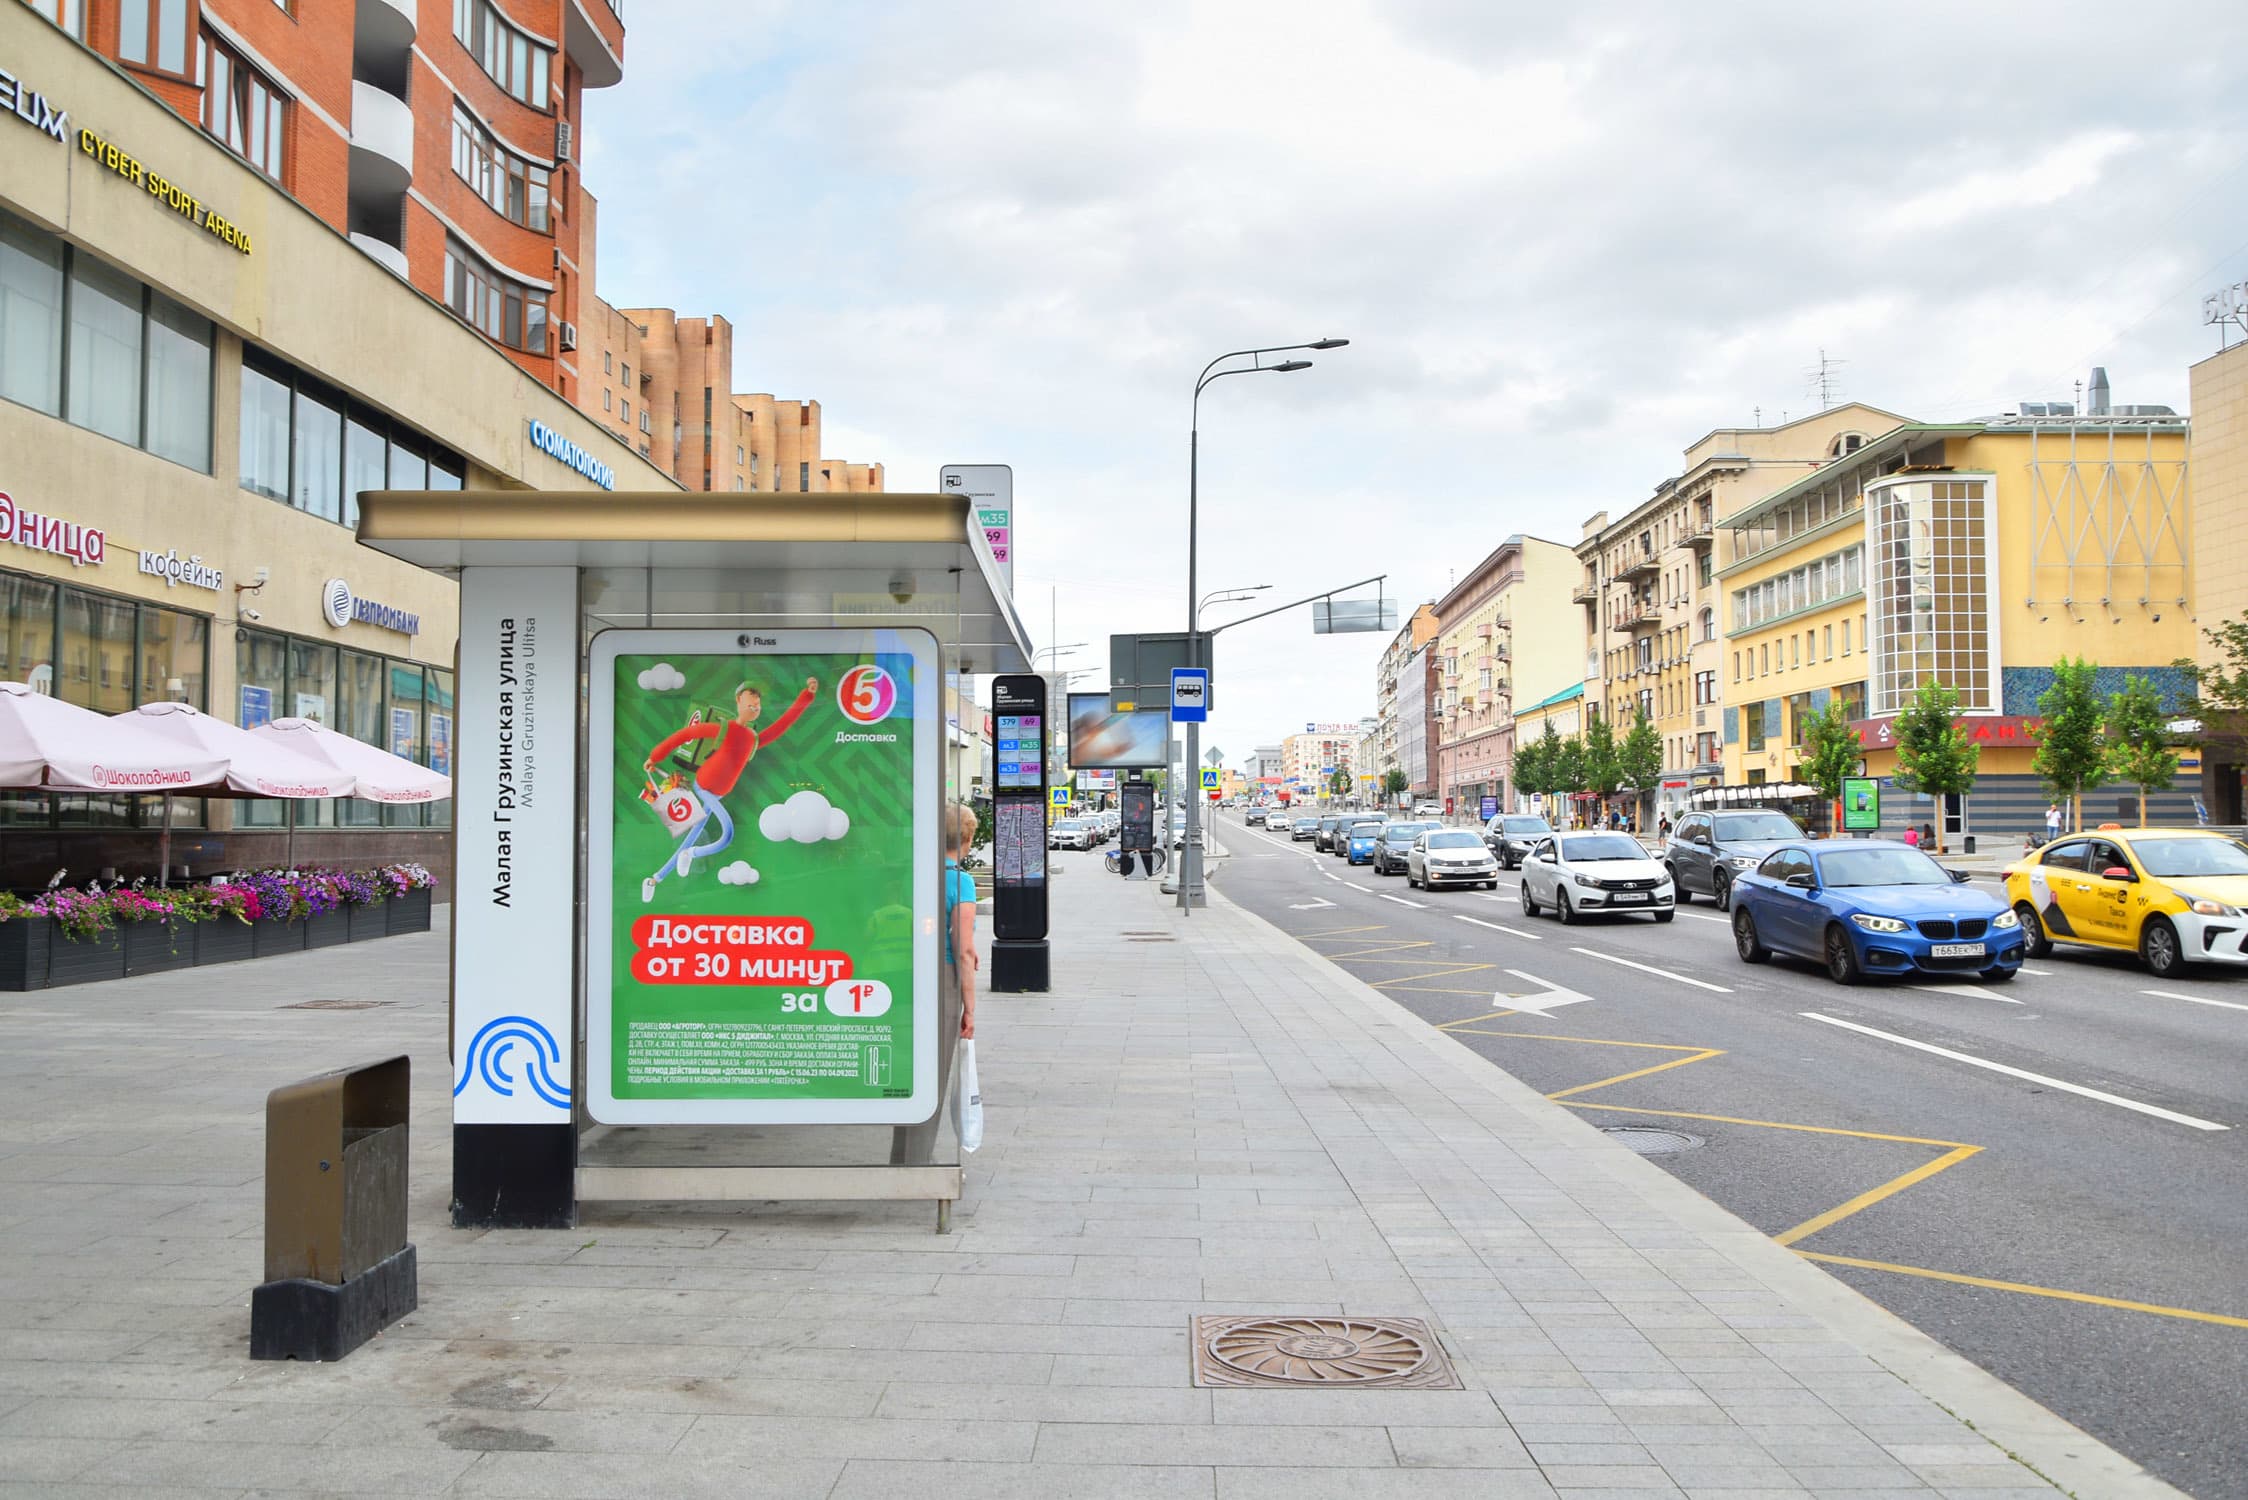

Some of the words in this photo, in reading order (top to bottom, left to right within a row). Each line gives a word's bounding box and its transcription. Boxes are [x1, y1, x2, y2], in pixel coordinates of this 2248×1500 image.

[81, 128, 142, 185] CYBER
[148, 171, 201, 223] SPORT
[205, 210, 252, 255] ARENA
[530, 420, 614, 491] СТОМАТОЛОГИЯ
[142, 549, 223, 589] кофейня
[352, 597, 420, 635] ГАЗПРОМБАНК
[500, 618, 518, 686] улица
[521, 617, 536, 658] Ulitsa
[753, 636, 777, 646] Russ
[521, 662, 537, 751] Gruzinskaya
[852, 668, 884, 714] 5
[493, 691, 517, 822] Грузинская
[835, 731, 897, 744] Доставка
[106, 768, 191, 785] Шоколадница
[520, 755, 536, 808] Malaya
[493, 830, 511, 908] Малая
[647, 919, 805, 948] Доставка
[647, 956, 685, 978] от
[694, 953, 731, 978] 30
[740, 957, 845, 985] минут
[781, 992, 818, 1013] за
[869, 1046, 888, 1085] 18+
